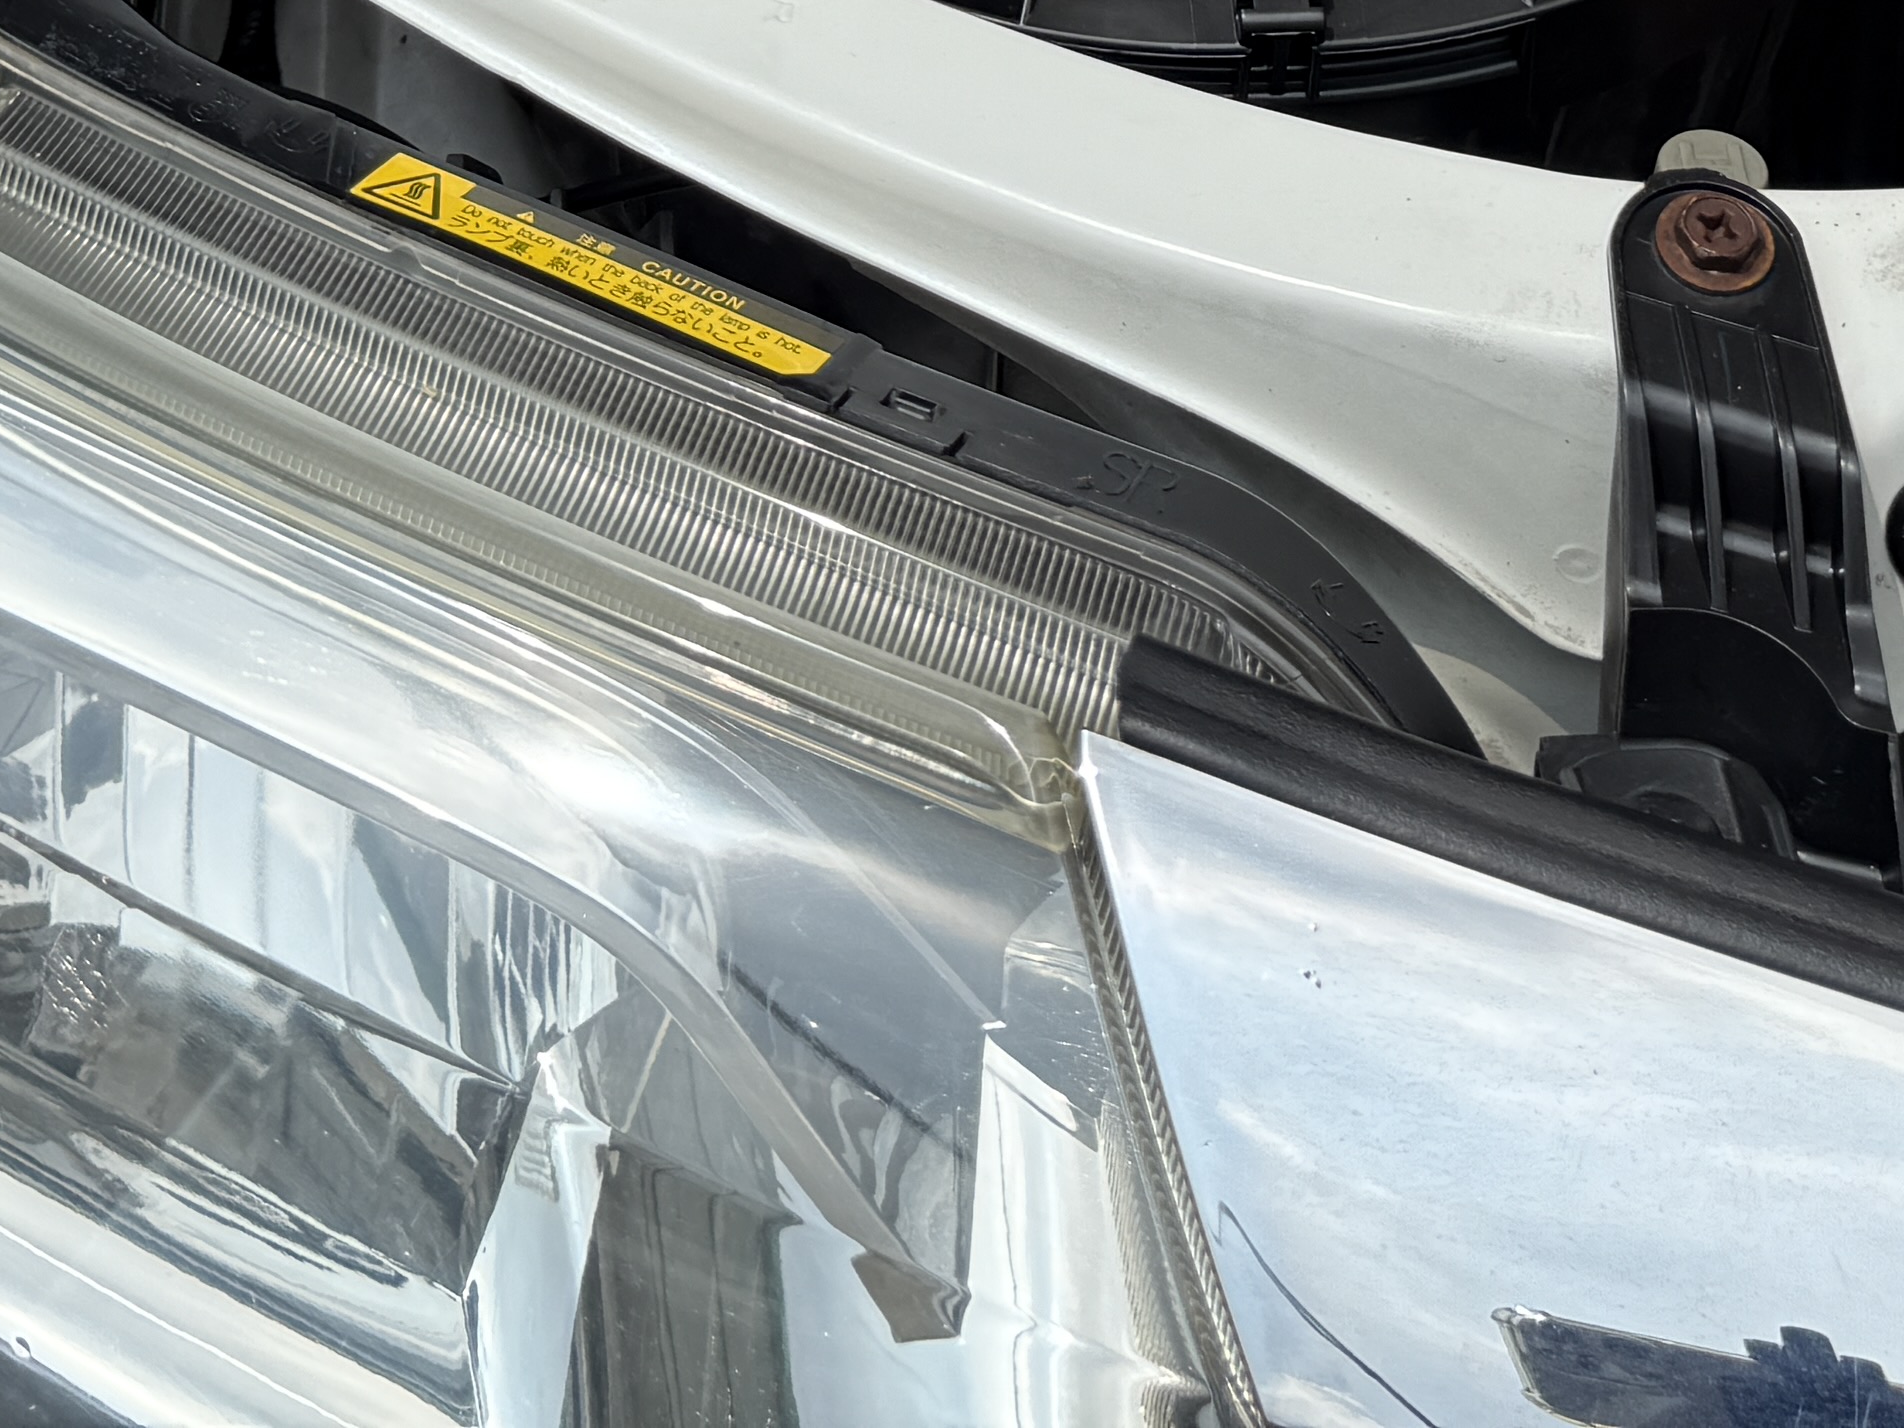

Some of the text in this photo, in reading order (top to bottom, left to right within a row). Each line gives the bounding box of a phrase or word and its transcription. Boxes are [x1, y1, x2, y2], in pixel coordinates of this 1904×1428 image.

[462, 204, 482, 218] Do
[487, 215, 512, 231] not
[516, 226, 555, 248] touch
[559, 245, 597, 265] when
[602, 263, 626, 278] the
[630, 276, 664, 295] back
[669, 291, 688, 304] of
[690, 301, 714, 316] the
[718, 312, 751, 332] lamp
[755, 330, 770, 341] is
[641, 260, 747, 311] CAUTION
